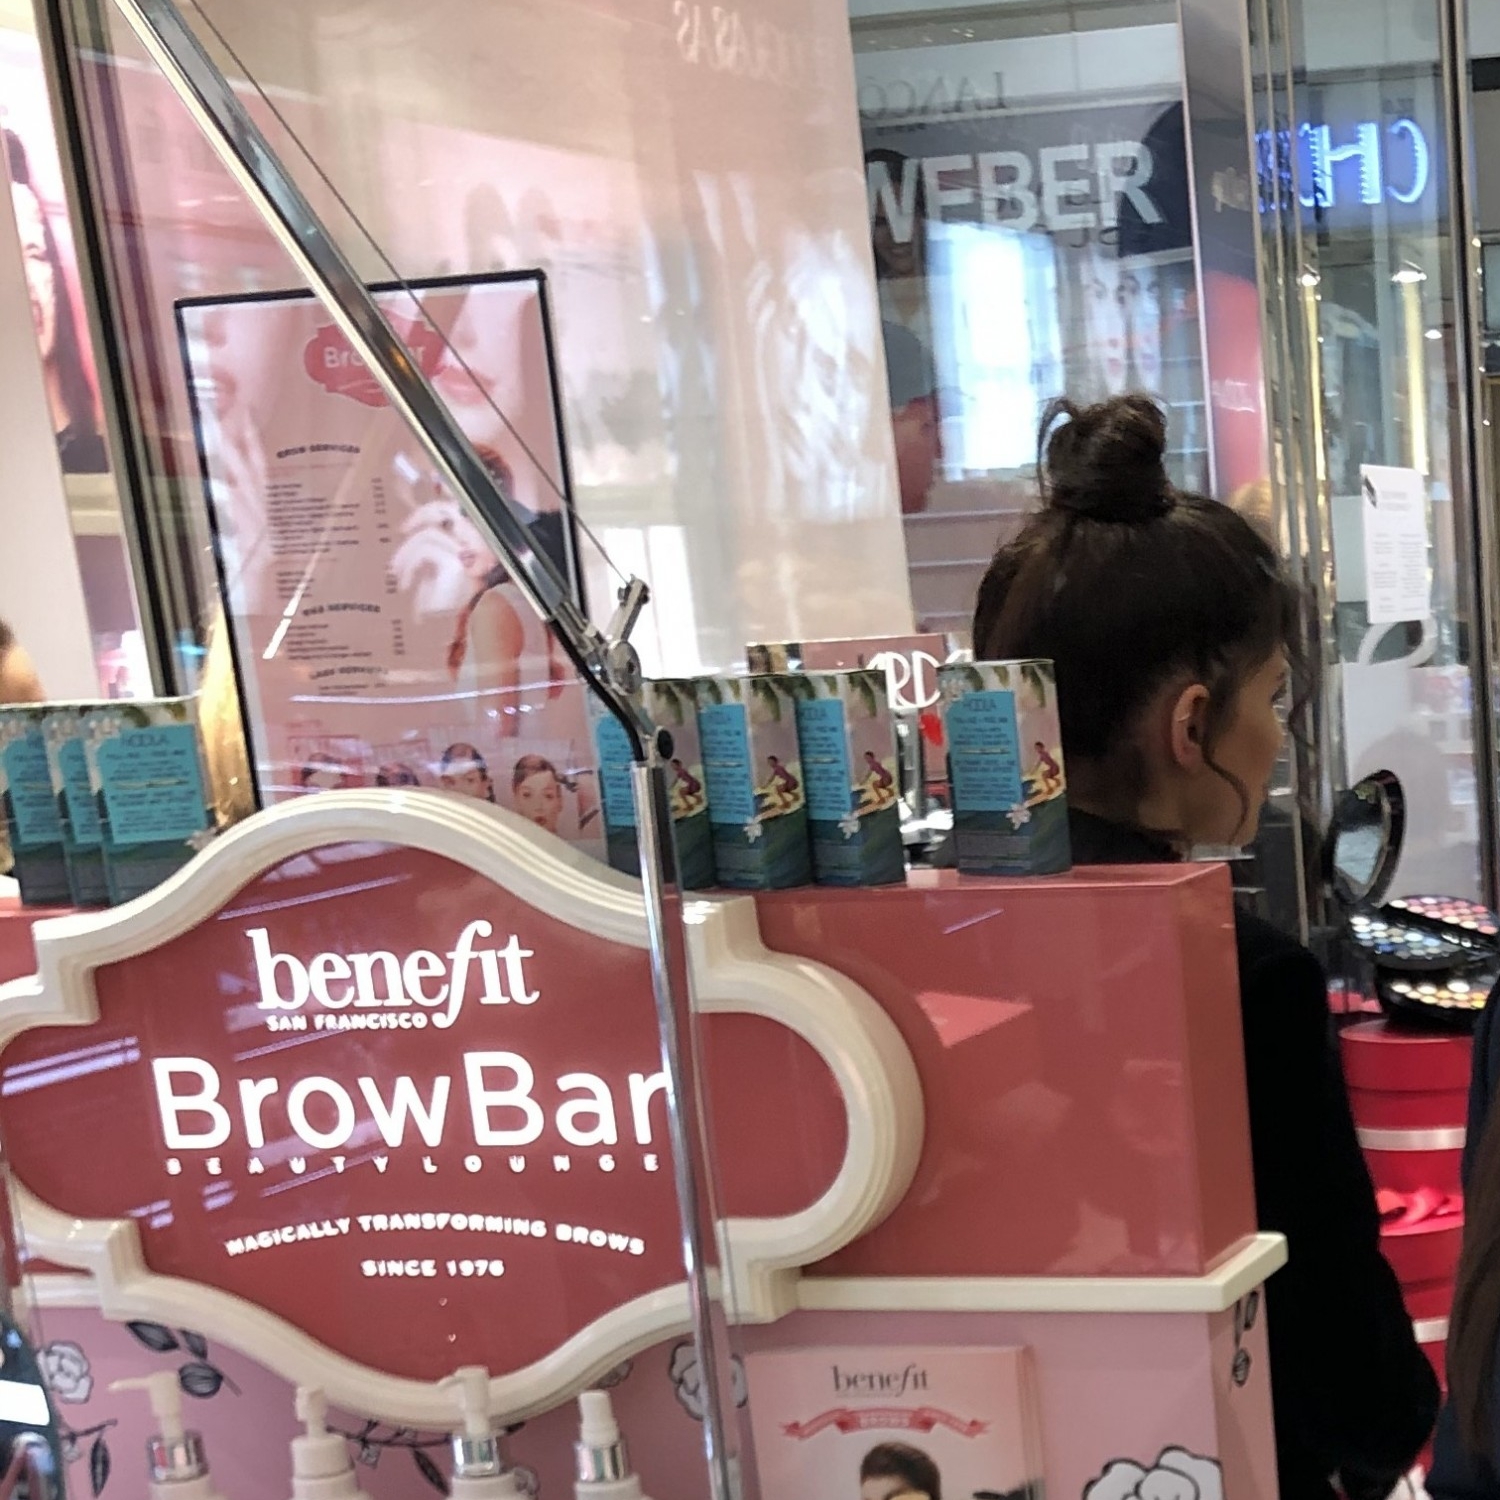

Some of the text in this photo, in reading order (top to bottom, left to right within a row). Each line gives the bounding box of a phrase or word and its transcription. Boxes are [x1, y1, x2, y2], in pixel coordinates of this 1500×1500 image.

[245, 919, 540, 1029] benefit
[266, 1012, 428, 1031] SAN FRANCISCO
[164, 1153, 660, 1175] BEAUTY LOUNGE
[224, 1212, 646, 1257] MAGICALLY TRANSFORMING BROWS
[360, 1259, 505, 1277] SINCE 1976
[831, 1363, 930, 1397] benefit
